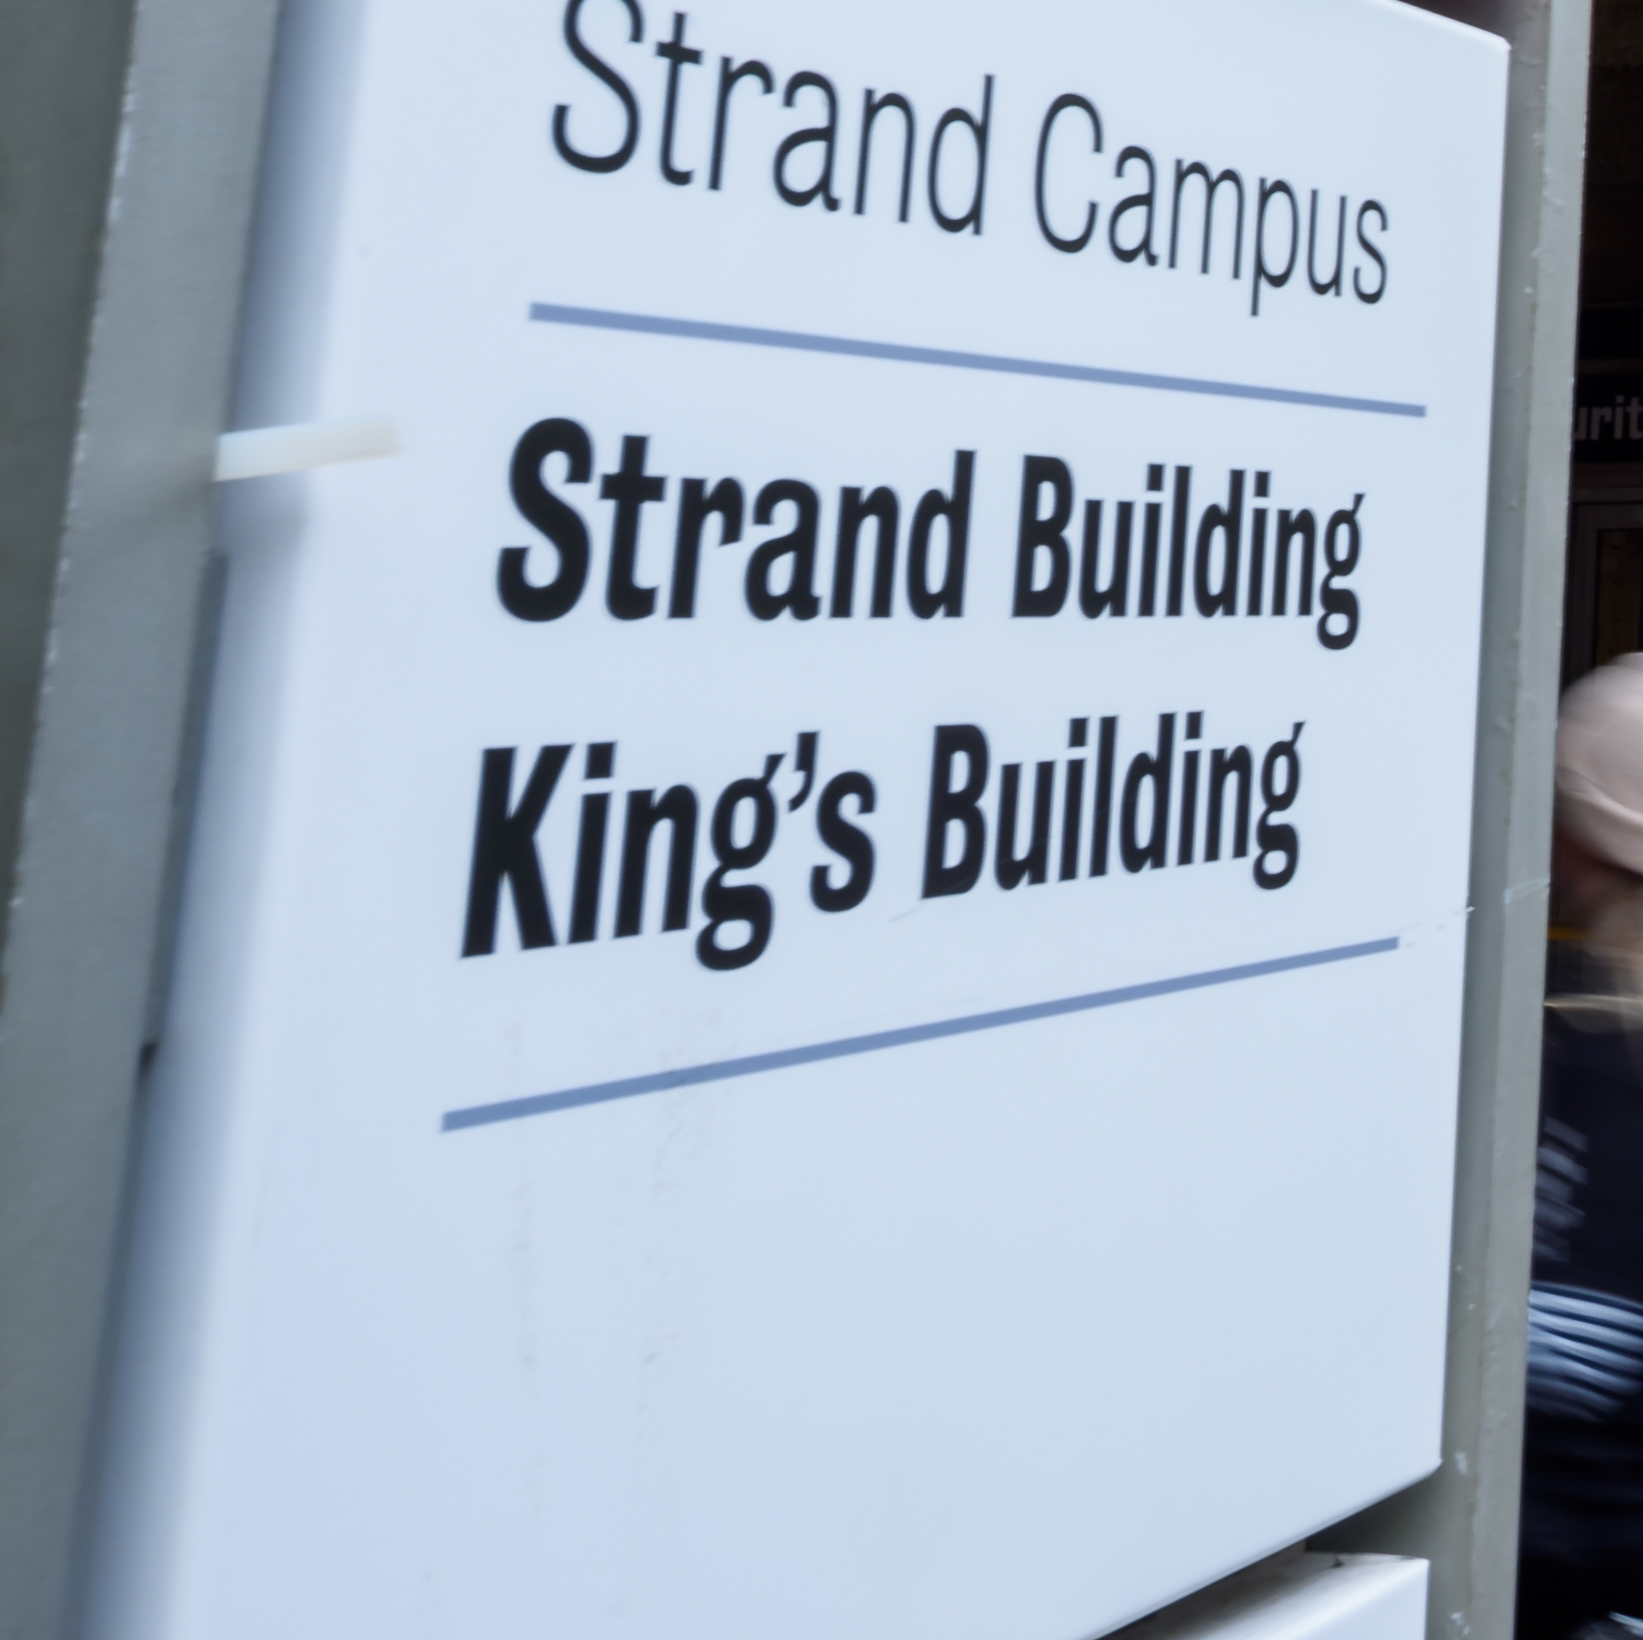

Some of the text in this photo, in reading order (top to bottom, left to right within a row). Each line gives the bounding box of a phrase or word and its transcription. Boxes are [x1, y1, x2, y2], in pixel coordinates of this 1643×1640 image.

[1031, 92, 1391, 317] Campus
[495, 415, 1368, 651] Strand Building
[458, 711, 1305, 974] King's Building
